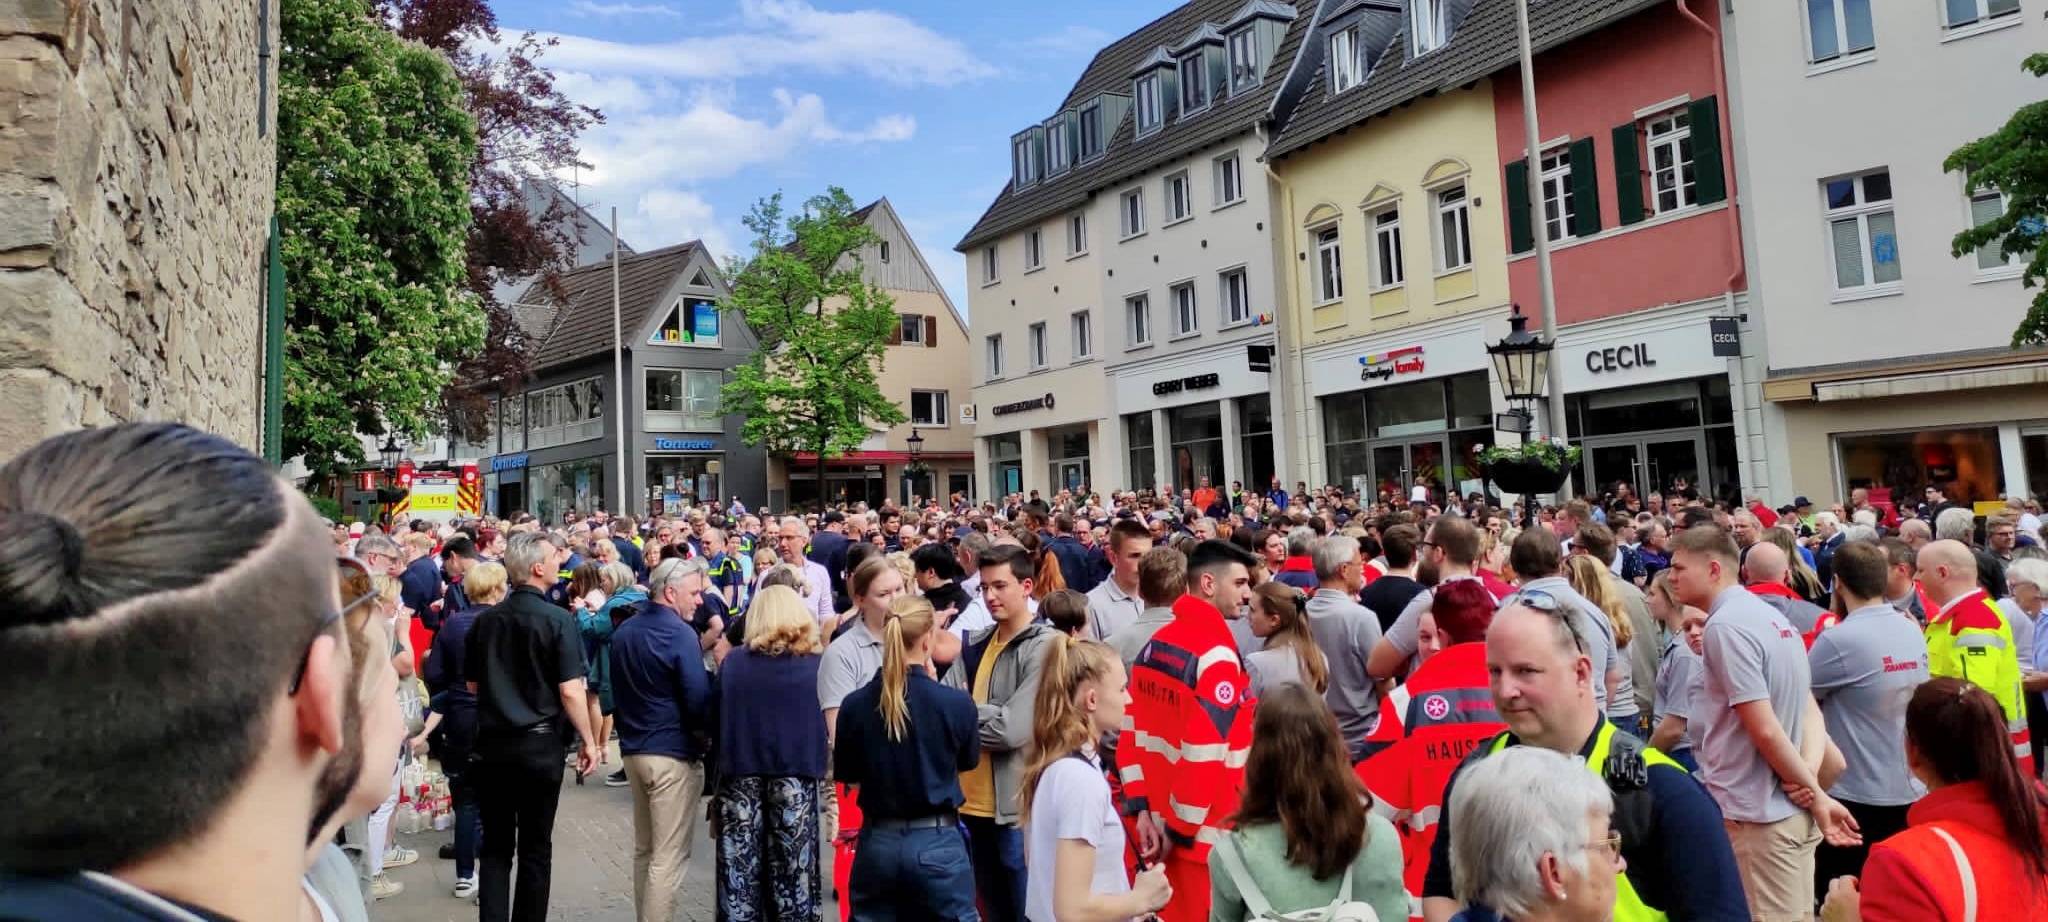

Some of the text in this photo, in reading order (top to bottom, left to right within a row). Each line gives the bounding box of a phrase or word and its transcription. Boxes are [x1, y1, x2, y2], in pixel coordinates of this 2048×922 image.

[1713, 333, 1737, 343] CECIL
[1394, 356, 1425, 373] family
[1586, 343, 1656, 373] CECIL
[1153, 372, 1219, 395] GERRY WEBER
[430, 496, 448, 504] 112
